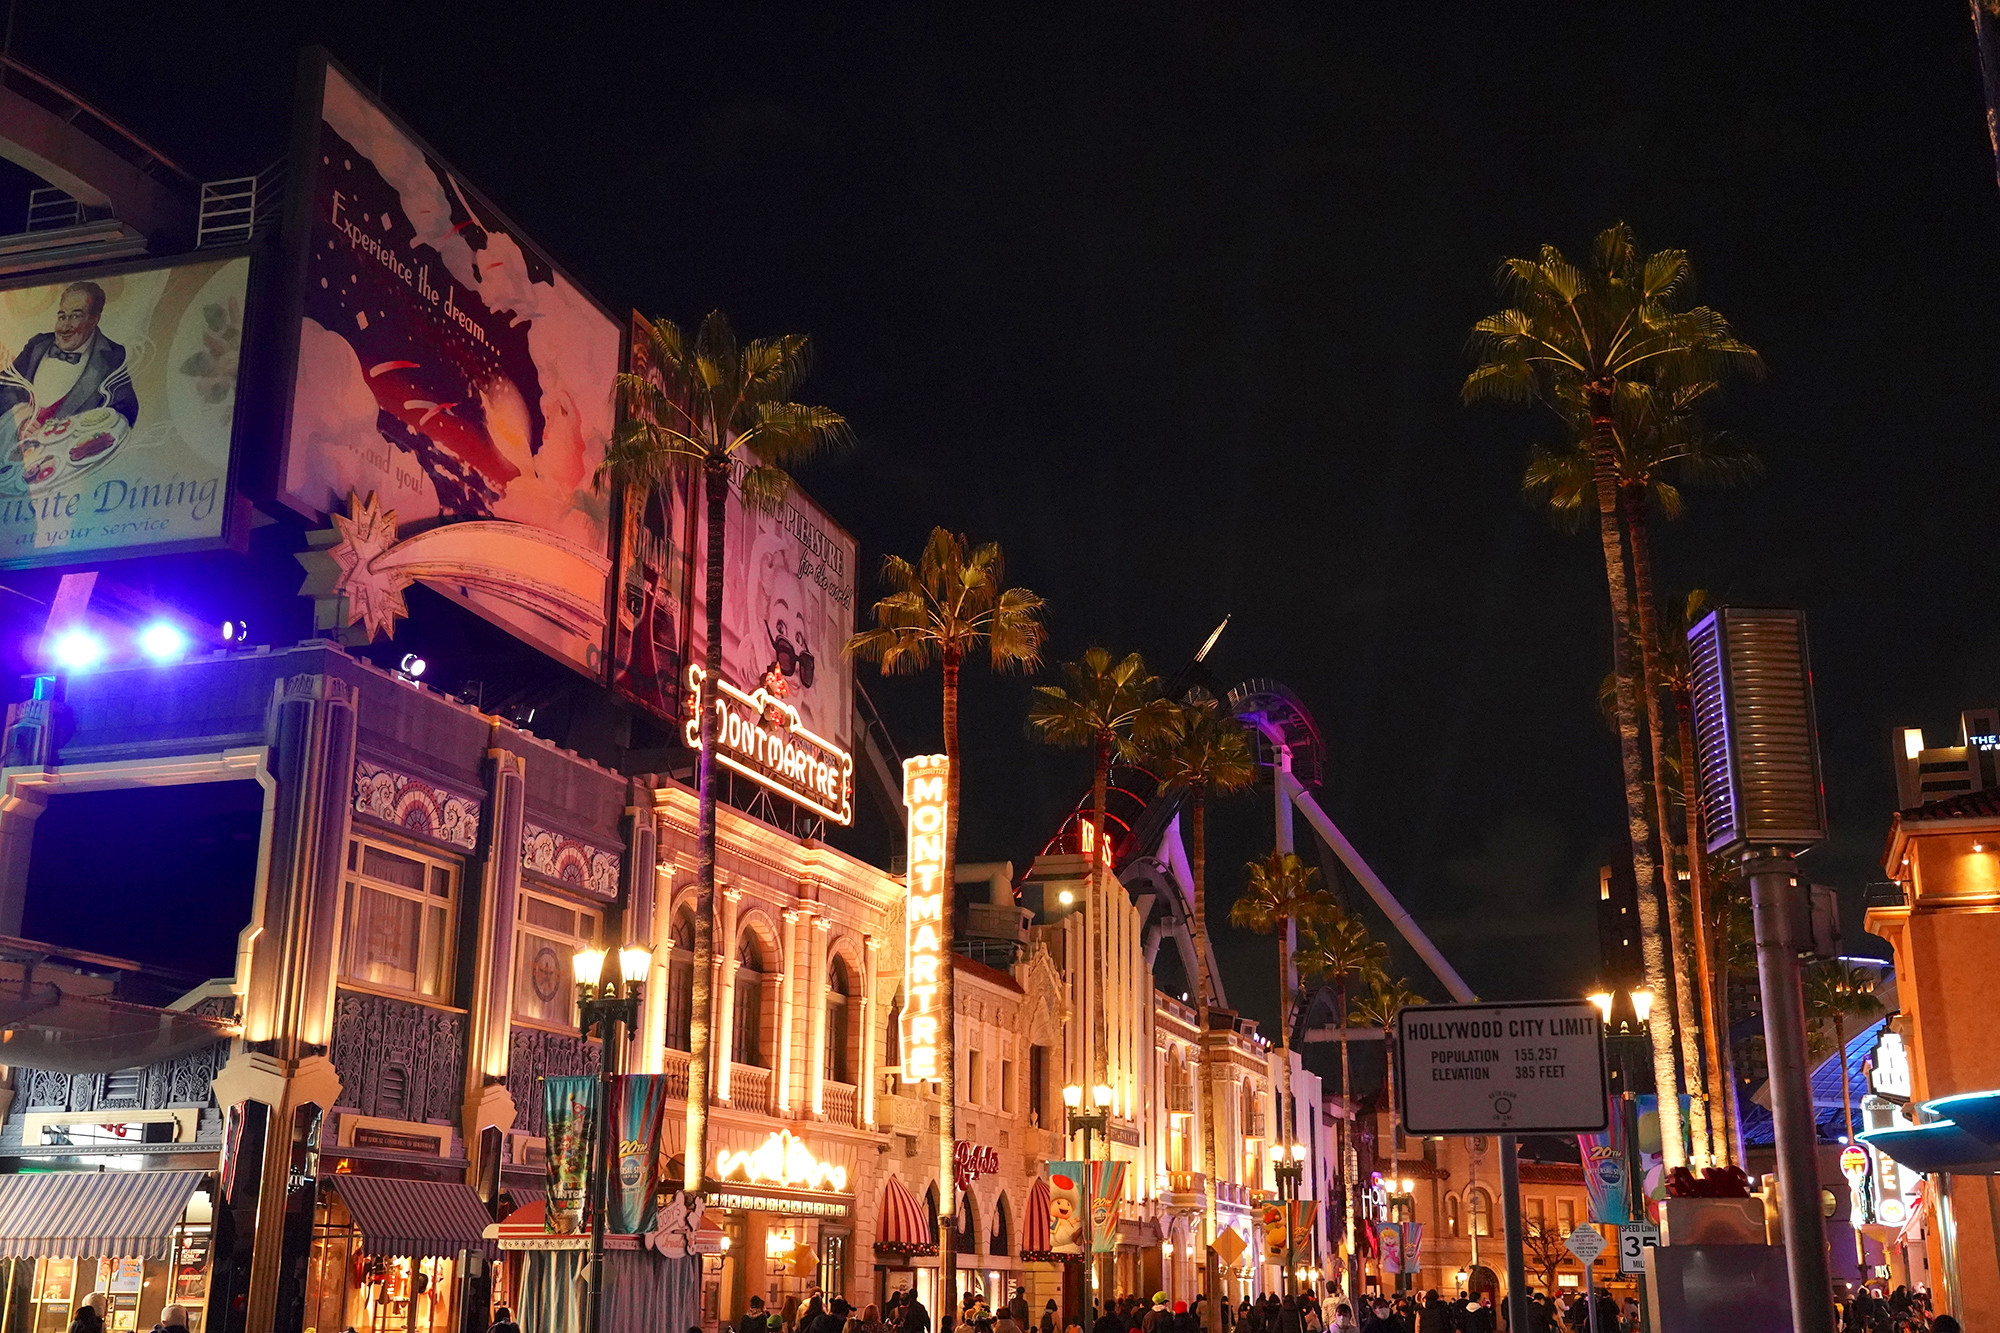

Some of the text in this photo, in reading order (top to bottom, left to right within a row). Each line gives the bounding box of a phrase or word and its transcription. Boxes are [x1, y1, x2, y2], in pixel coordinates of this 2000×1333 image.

[331, 189, 501, 357] Experience the dream...
[395, 466, 425, 496] you!
[93, 472, 219, 521] Dining
[15, 517, 170, 549] at your service
[784, 501, 844, 579] PLEASURE
[797, 548, 853, 611] for the world
[1970, 735, 1997, 745] THE
[911, 777, 943, 1078] MONTMARTRE
[1407, 1017, 1594, 1041] HOLLYWOOD CITY LIMIT
[1431, 1047, 1559, 1064] POPULATION 155,257
[1432, 1064, 1566, 1081] ELEVATION 385 FEET
[618, 1139, 649, 1159] 20TH
[1589, 1146, 1622, 1161] 20TH
[1621, 1223, 1658, 1233] SPEED LIMIT
